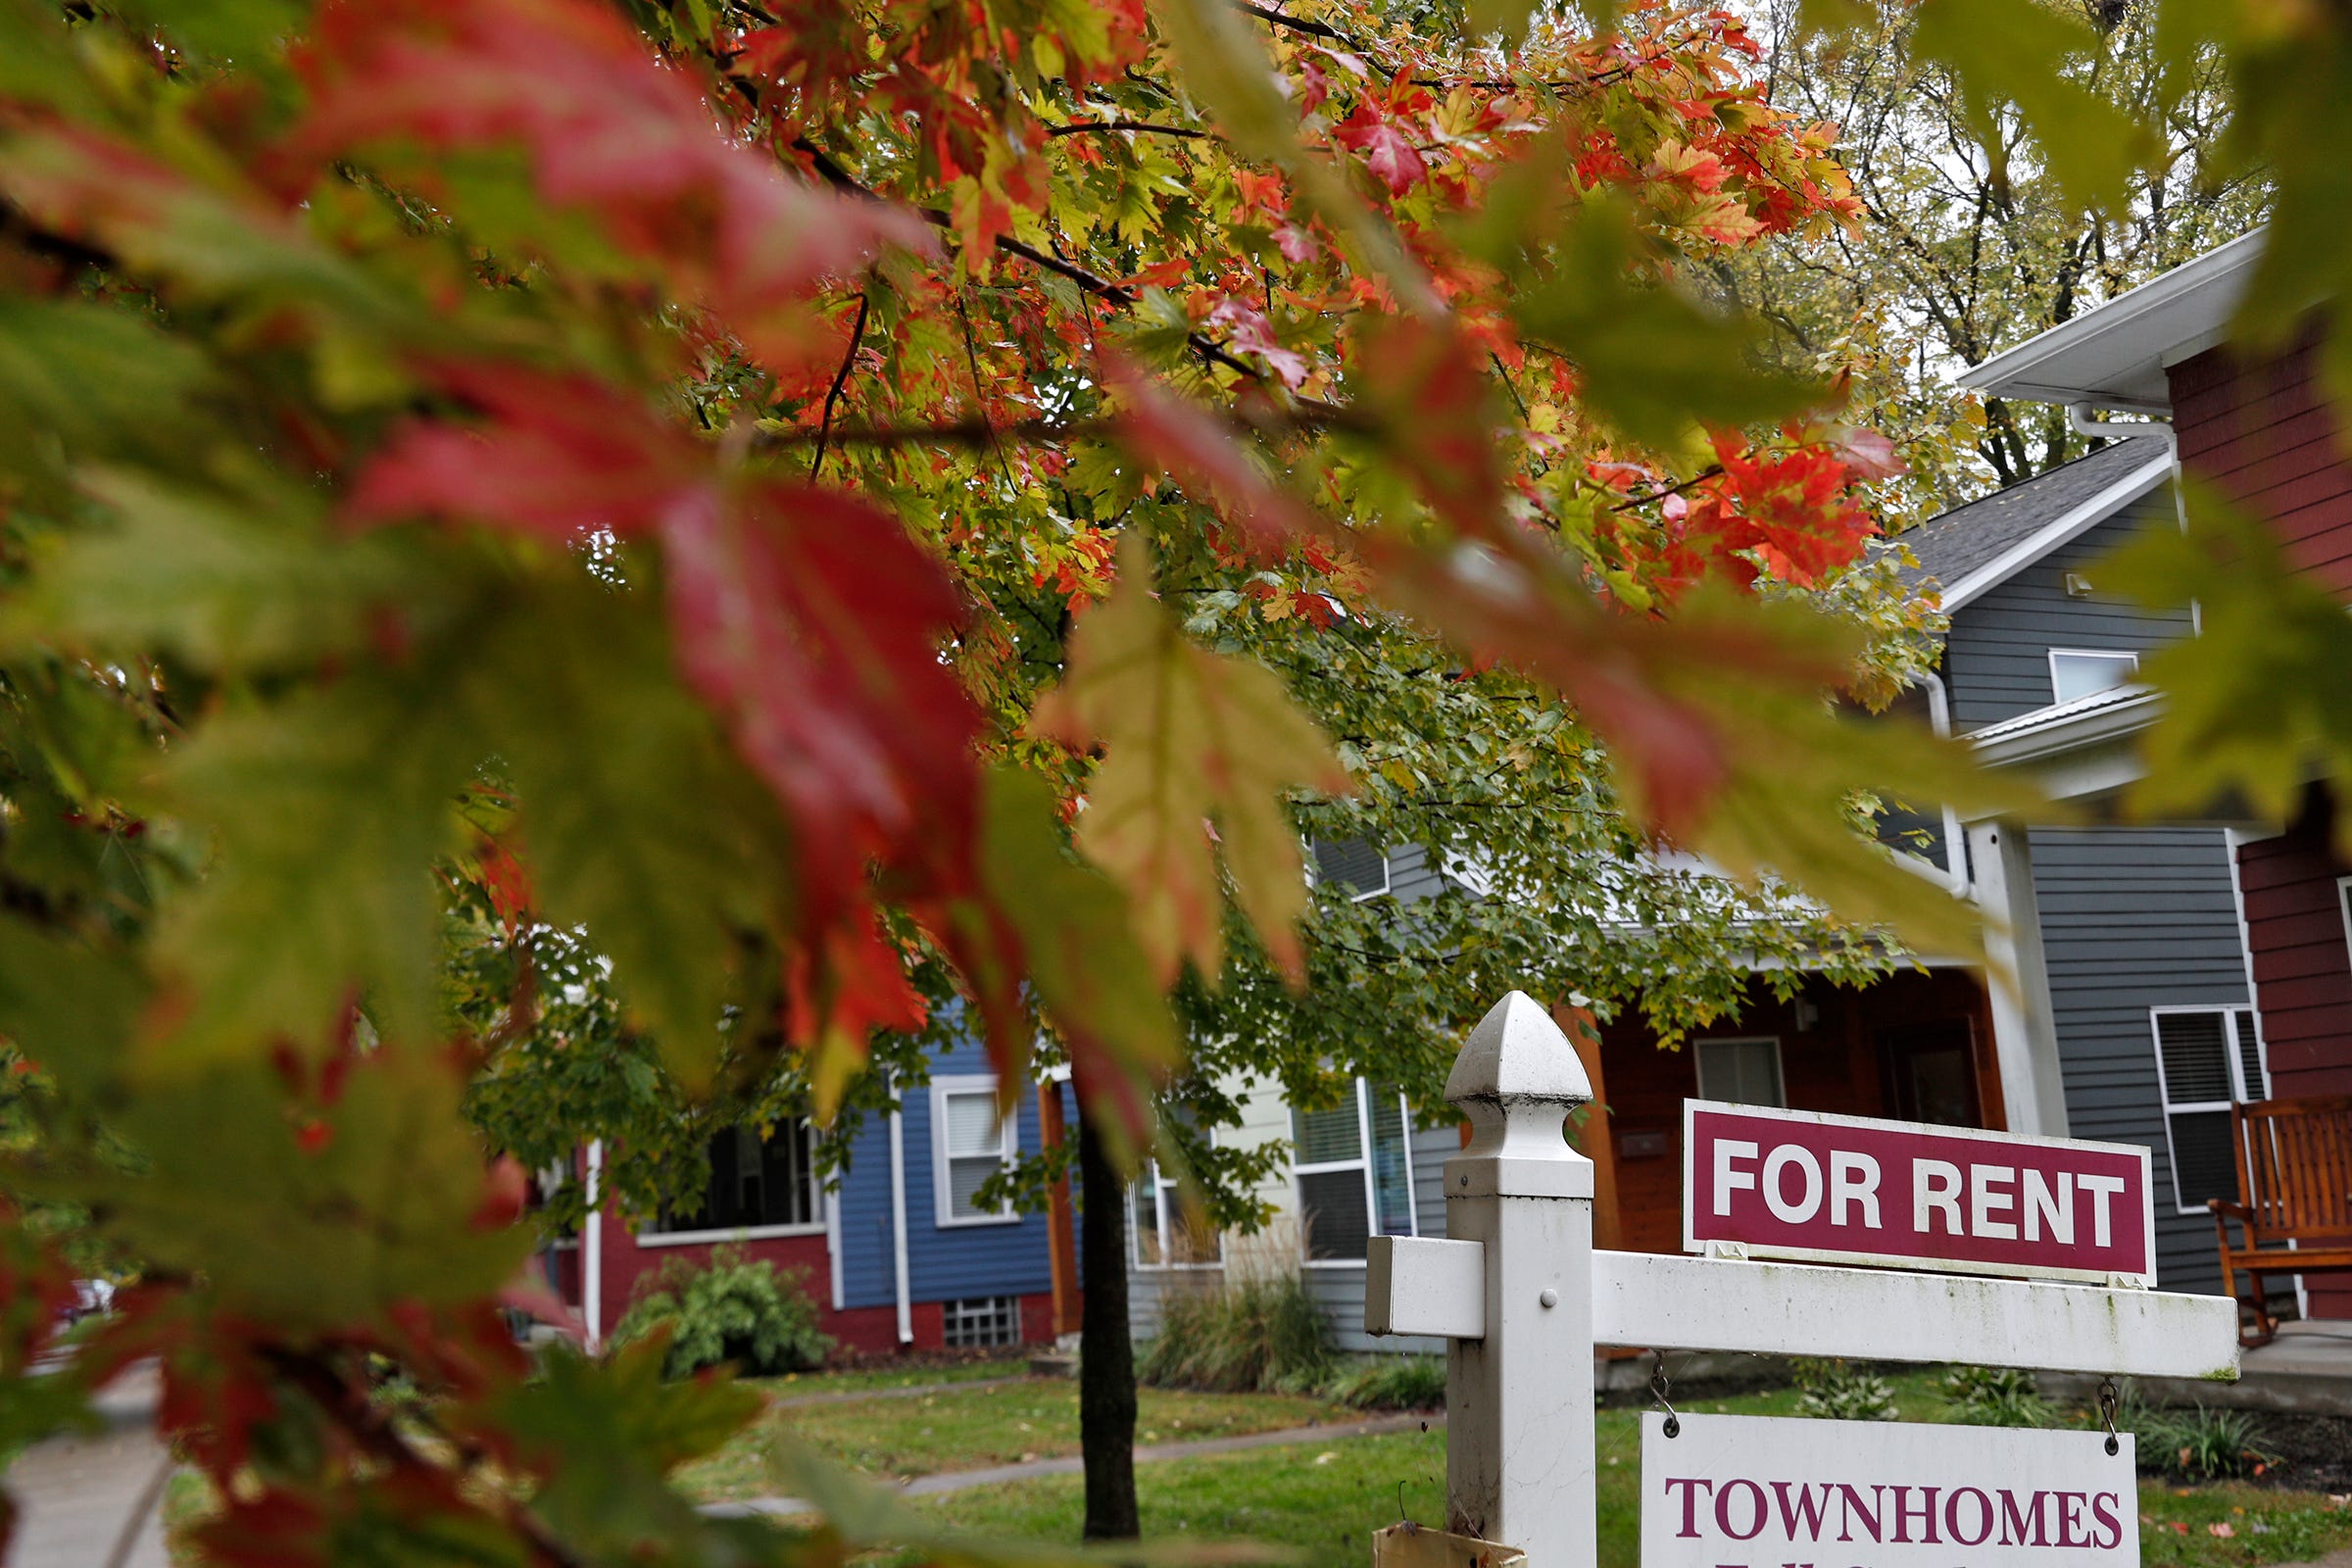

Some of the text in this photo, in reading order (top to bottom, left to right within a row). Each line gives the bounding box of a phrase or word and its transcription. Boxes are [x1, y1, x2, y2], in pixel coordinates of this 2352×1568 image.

[1712, 1138, 2125, 1248] FOR RENT
[1665, 1478, 2123, 1549] TOWNHOMES
